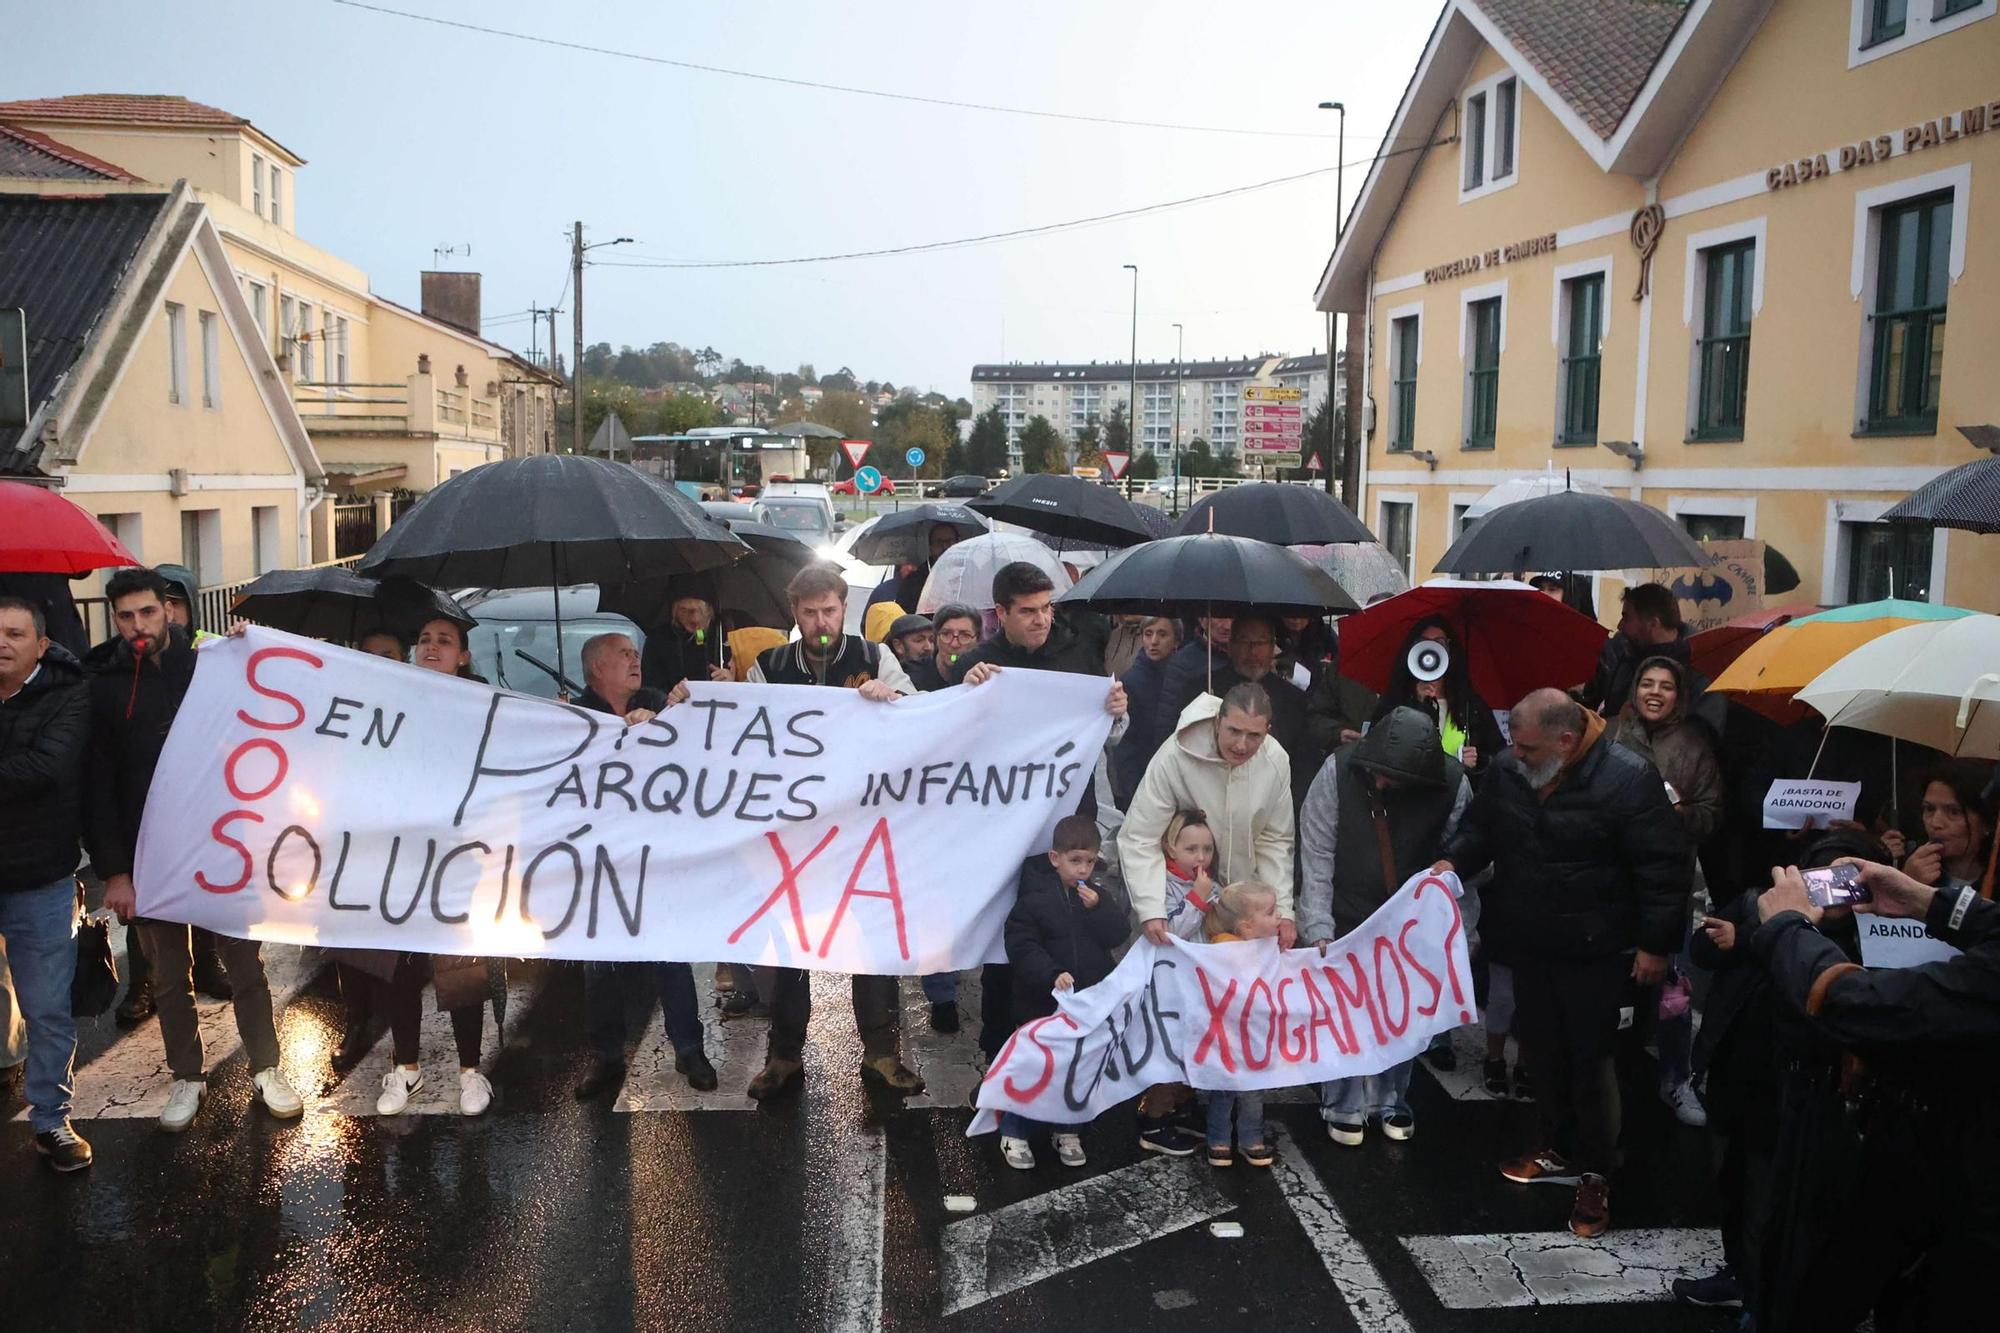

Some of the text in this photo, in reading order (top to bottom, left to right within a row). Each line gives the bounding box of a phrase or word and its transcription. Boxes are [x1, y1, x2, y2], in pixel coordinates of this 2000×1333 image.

[1766, 154, 1830, 192] CASA
[1839, 135, 1892, 170] DAS
[1424, 232, 1558, 284] CONCELLO DE CAMBRE
[860, 741, 1081, 807] INFANTÍS
[1782, 788, 1844, 798] ¡BASTA DE
[1771, 798, 1846, 811] ABANDONO!
[727, 816, 910, 960] XA
[1194, 877, 1473, 1074] XOGAMOS?
